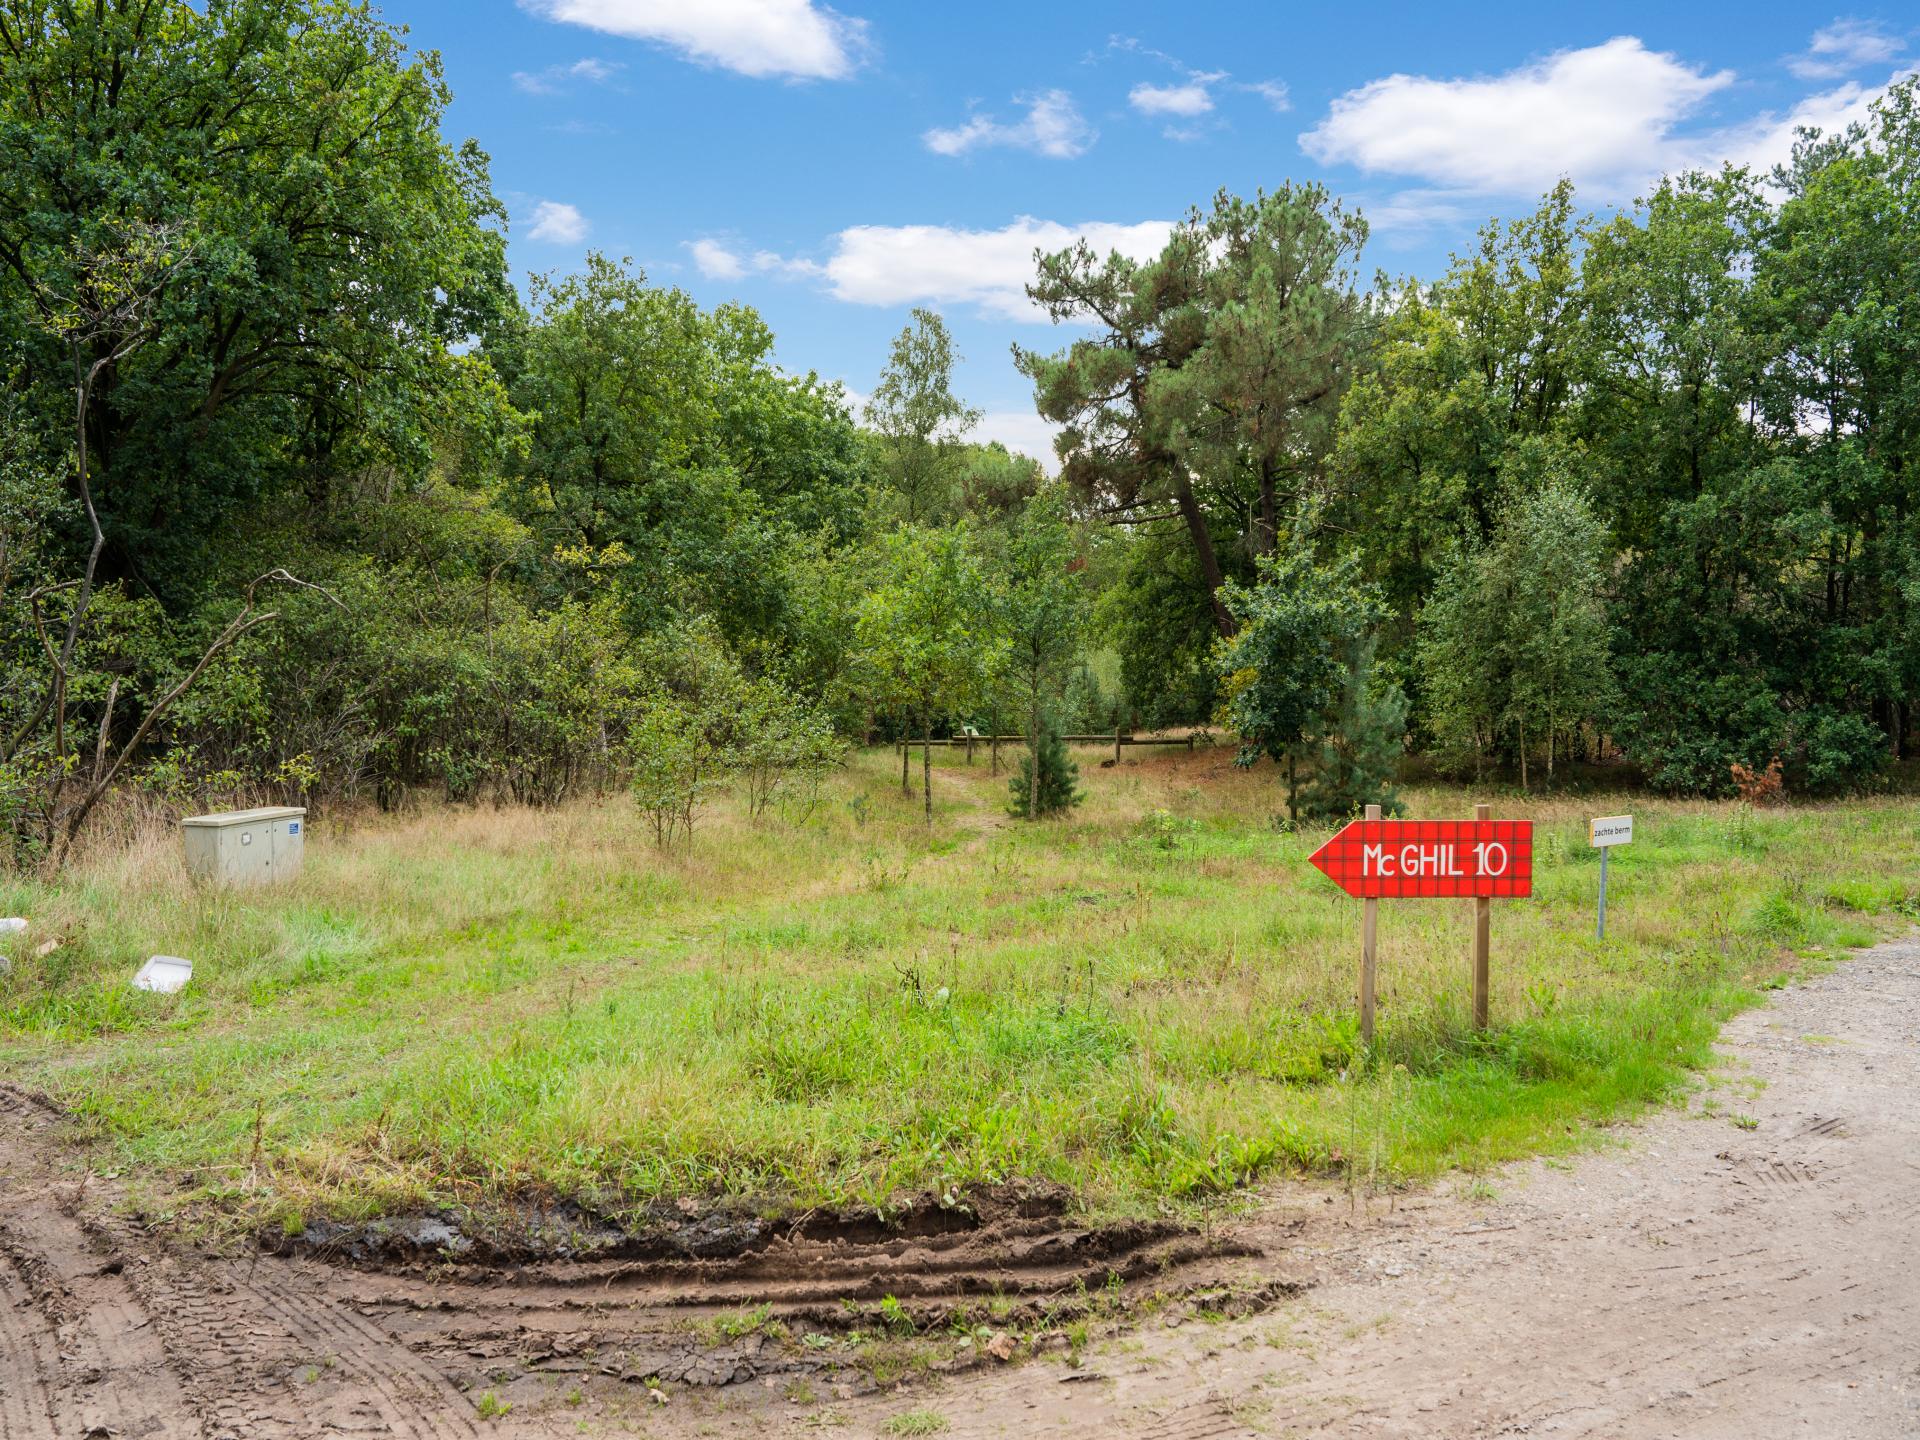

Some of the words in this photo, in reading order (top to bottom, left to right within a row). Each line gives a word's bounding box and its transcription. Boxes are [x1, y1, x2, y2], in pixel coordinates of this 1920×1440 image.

[1594, 827, 1614, 836] zachte
[1614, 826, 1631, 834] berm
[1472, 842, 1508, 876] 10
